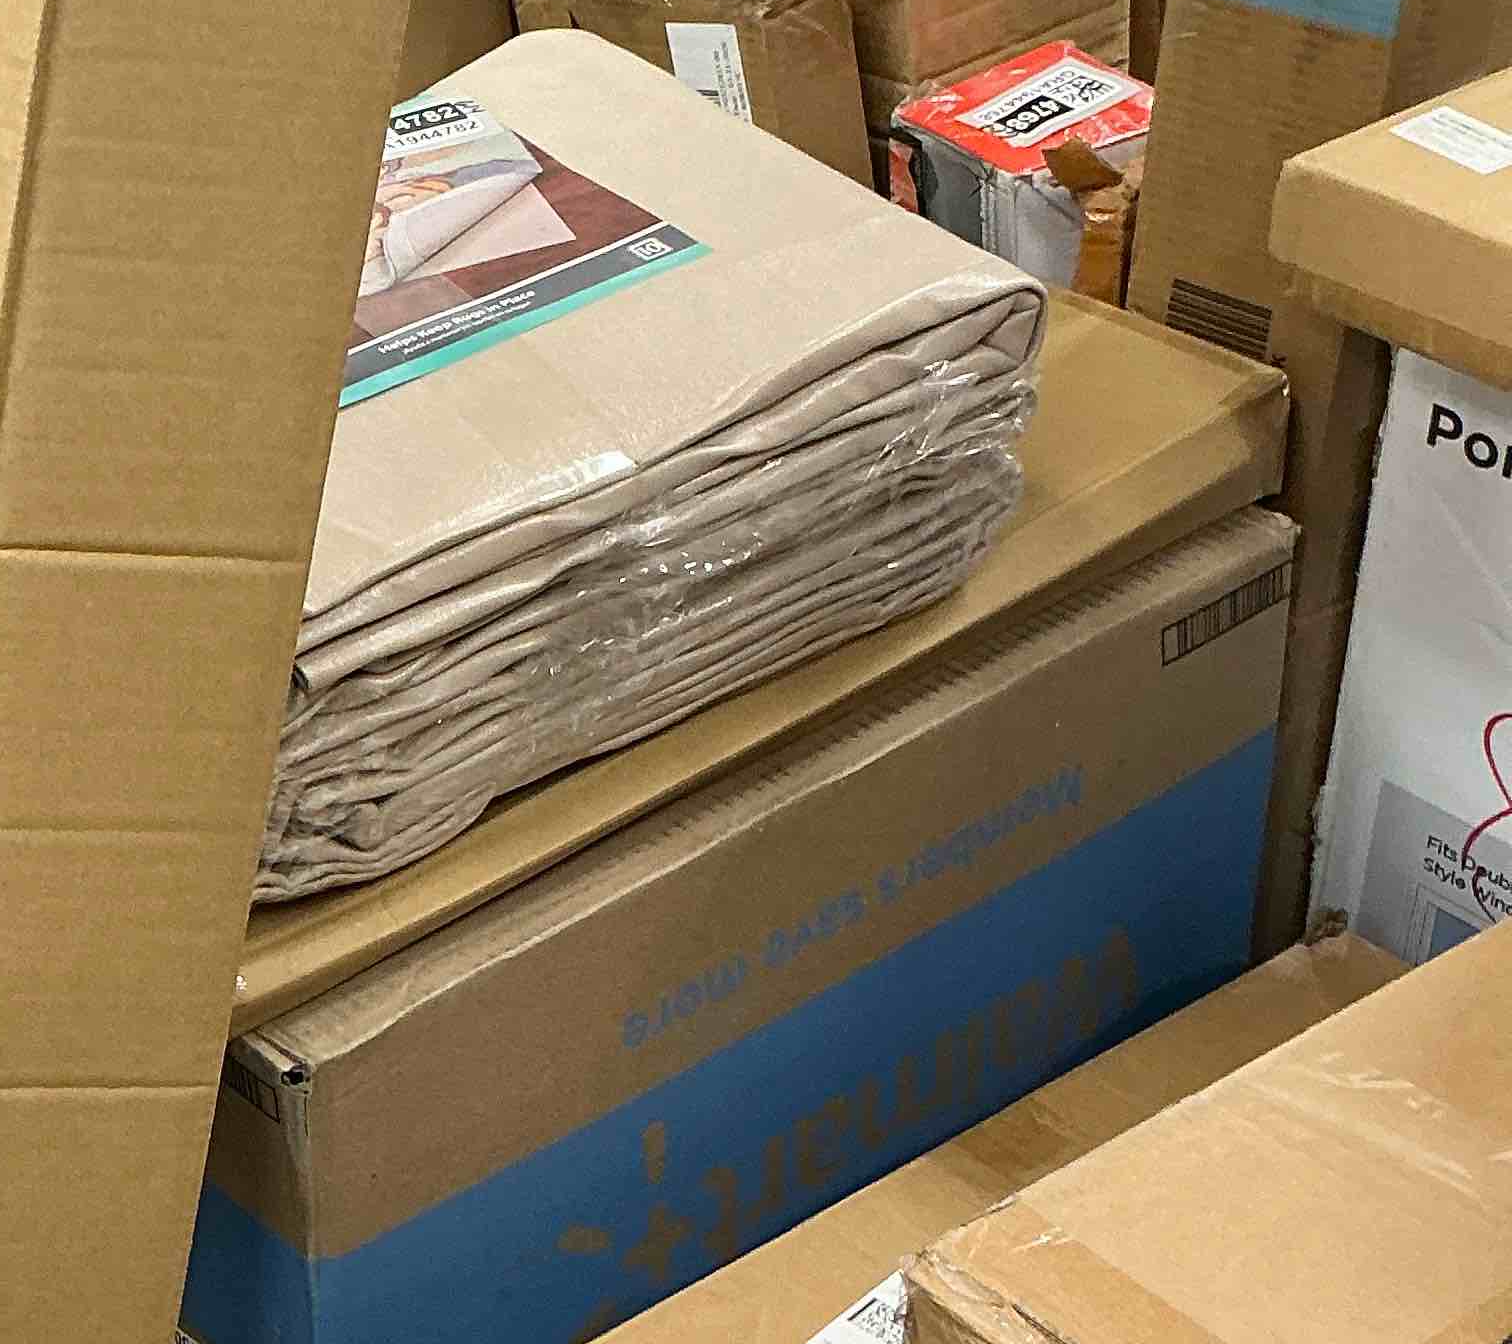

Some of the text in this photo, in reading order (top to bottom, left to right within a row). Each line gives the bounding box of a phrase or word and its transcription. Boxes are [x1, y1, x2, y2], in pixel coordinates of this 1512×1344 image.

[394, 107, 460, 131] 4782
[1005, 97, 1062, 133] 4768
[1427, 835, 1458, 862] Fits
[1424, 857, 1466, 890] Style
